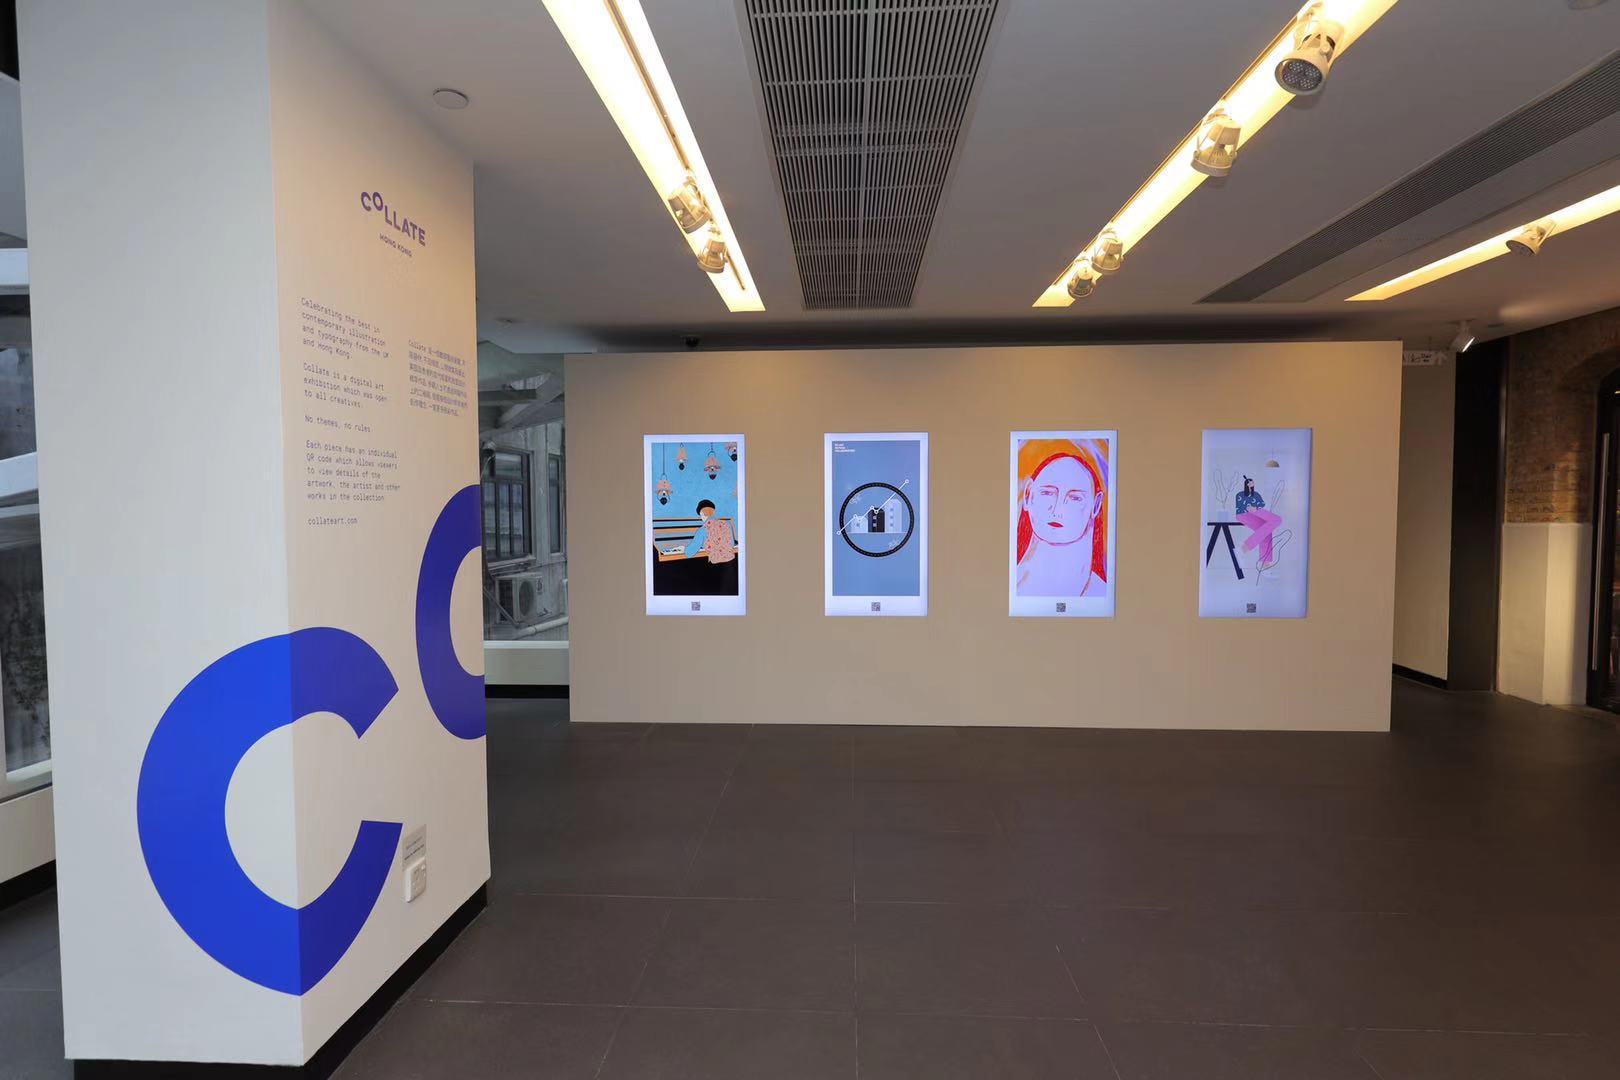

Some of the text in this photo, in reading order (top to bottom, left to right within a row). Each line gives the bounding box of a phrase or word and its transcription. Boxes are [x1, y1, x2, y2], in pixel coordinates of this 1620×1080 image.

[361, 191, 426, 247] COLLATE
[301, 297, 381, 333] Celebrating the best in
[302, 312, 385, 347] contemporary illustration
[303, 326, 314, 335] and
[318, 330, 353, 349] typography
[355, 341, 369, 353] from
[371, 347, 380, 356] the
[303, 338, 315, 347] and
[318, 340, 334, 355] Hong
[303, 362, 330, 377] Collate
[333, 371, 341, 380] is
[350, 376, 373, 389] digital
[375, 383, 384, 392] art
[303, 377, 341, 391] exhibition
[343, 386, 361, 397] which
[363, 391, 373, 400] was
[304, 389, 313, 398] to
[316, 391, 327, 401] all
[304, 415, 314, 424] No
[344, 422, 353, 430] no
[306, 440, 321, 449] Each
[324, 444, 342, 454] piece
[344, 446, 356, 454] has
[368, 448, 397, 459] individual
[306, 453, 398, 470] QR code which allows viewers
[307, 466, 381, 480] to view details of the
[339, 481, 350, 489] the
[353, 482, 373, 491] artist
[307, 492, 327, 501] works
[329, 493, 337, 501] in
[339, 493, 350, 501] the
[308, 516, 358, 526] collateart.com
